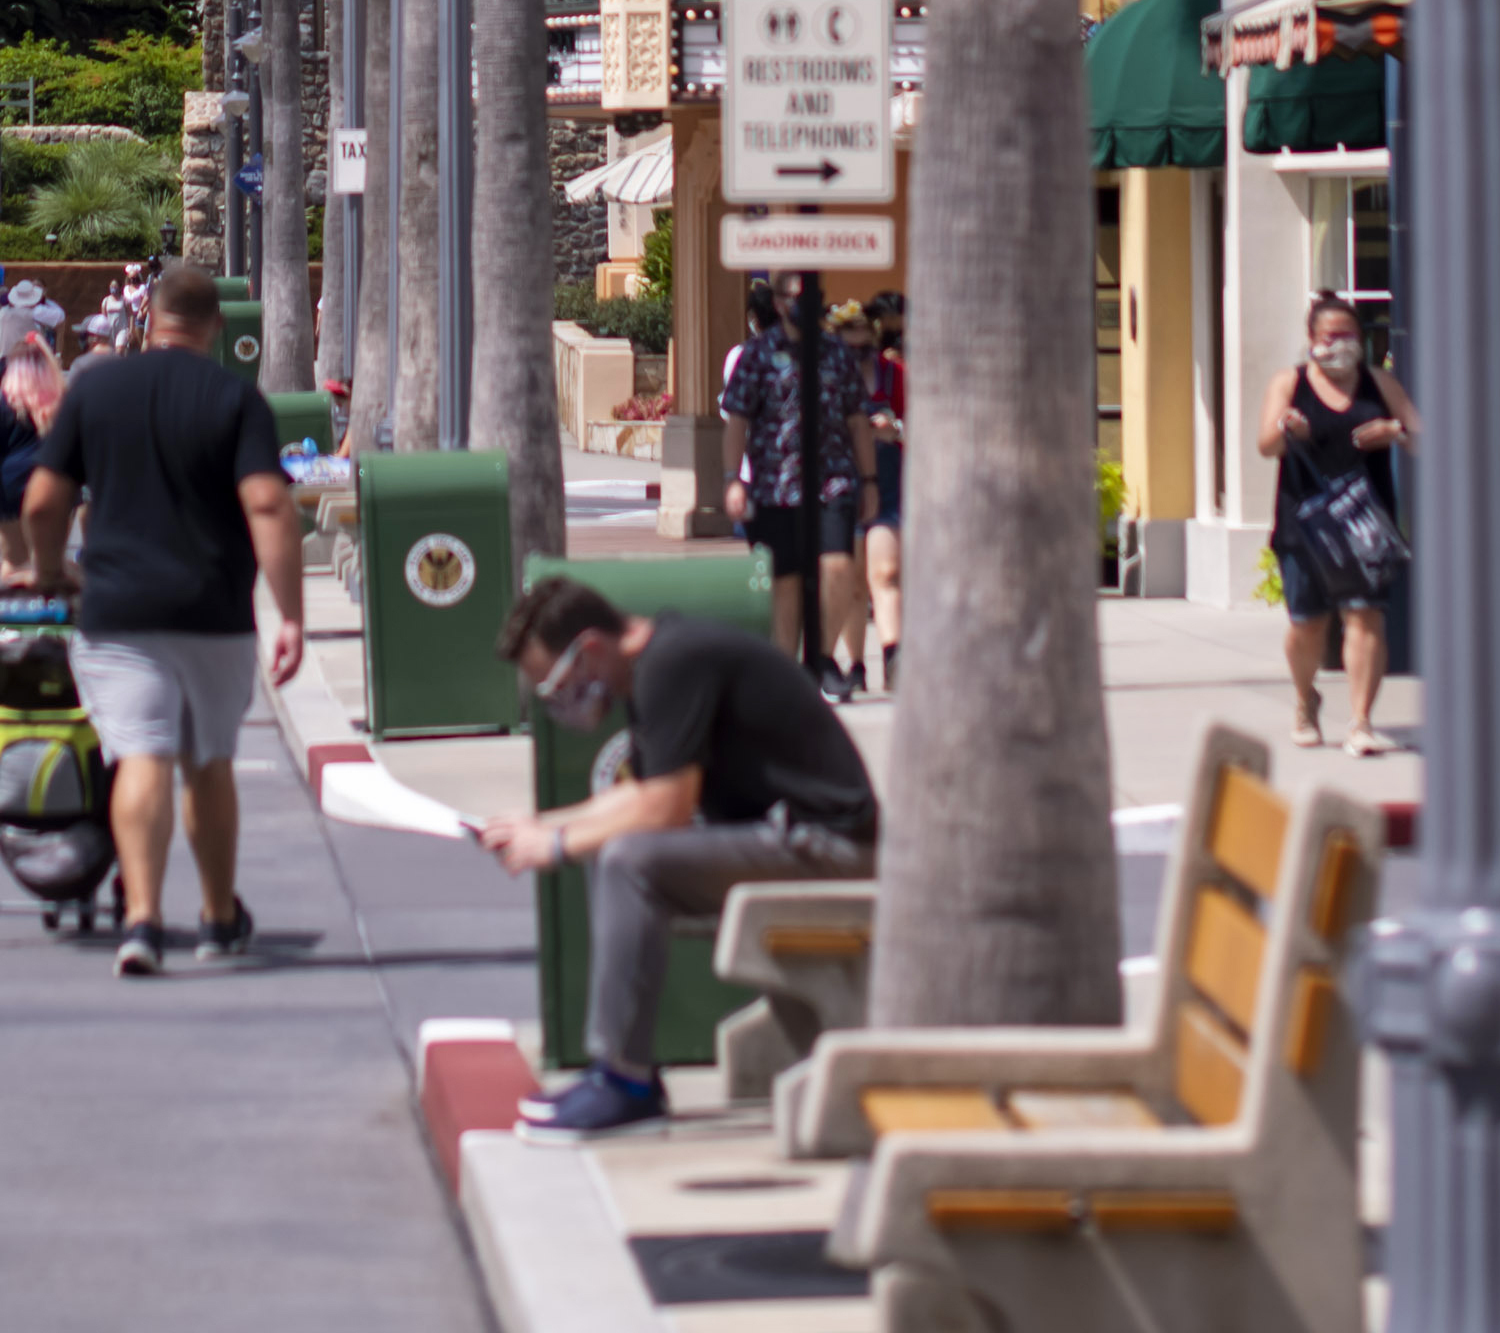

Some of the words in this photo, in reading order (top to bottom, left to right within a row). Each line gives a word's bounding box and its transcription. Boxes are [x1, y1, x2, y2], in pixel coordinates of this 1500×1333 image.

[743, 55, 877, 84] RESTROOMS
[786, 90, 835, 116] AND
[743, 122, 878, 152] TELEPHONES
[737, 231, 819, 252] LOADING
[823, 231, 880, 252] DOCK
